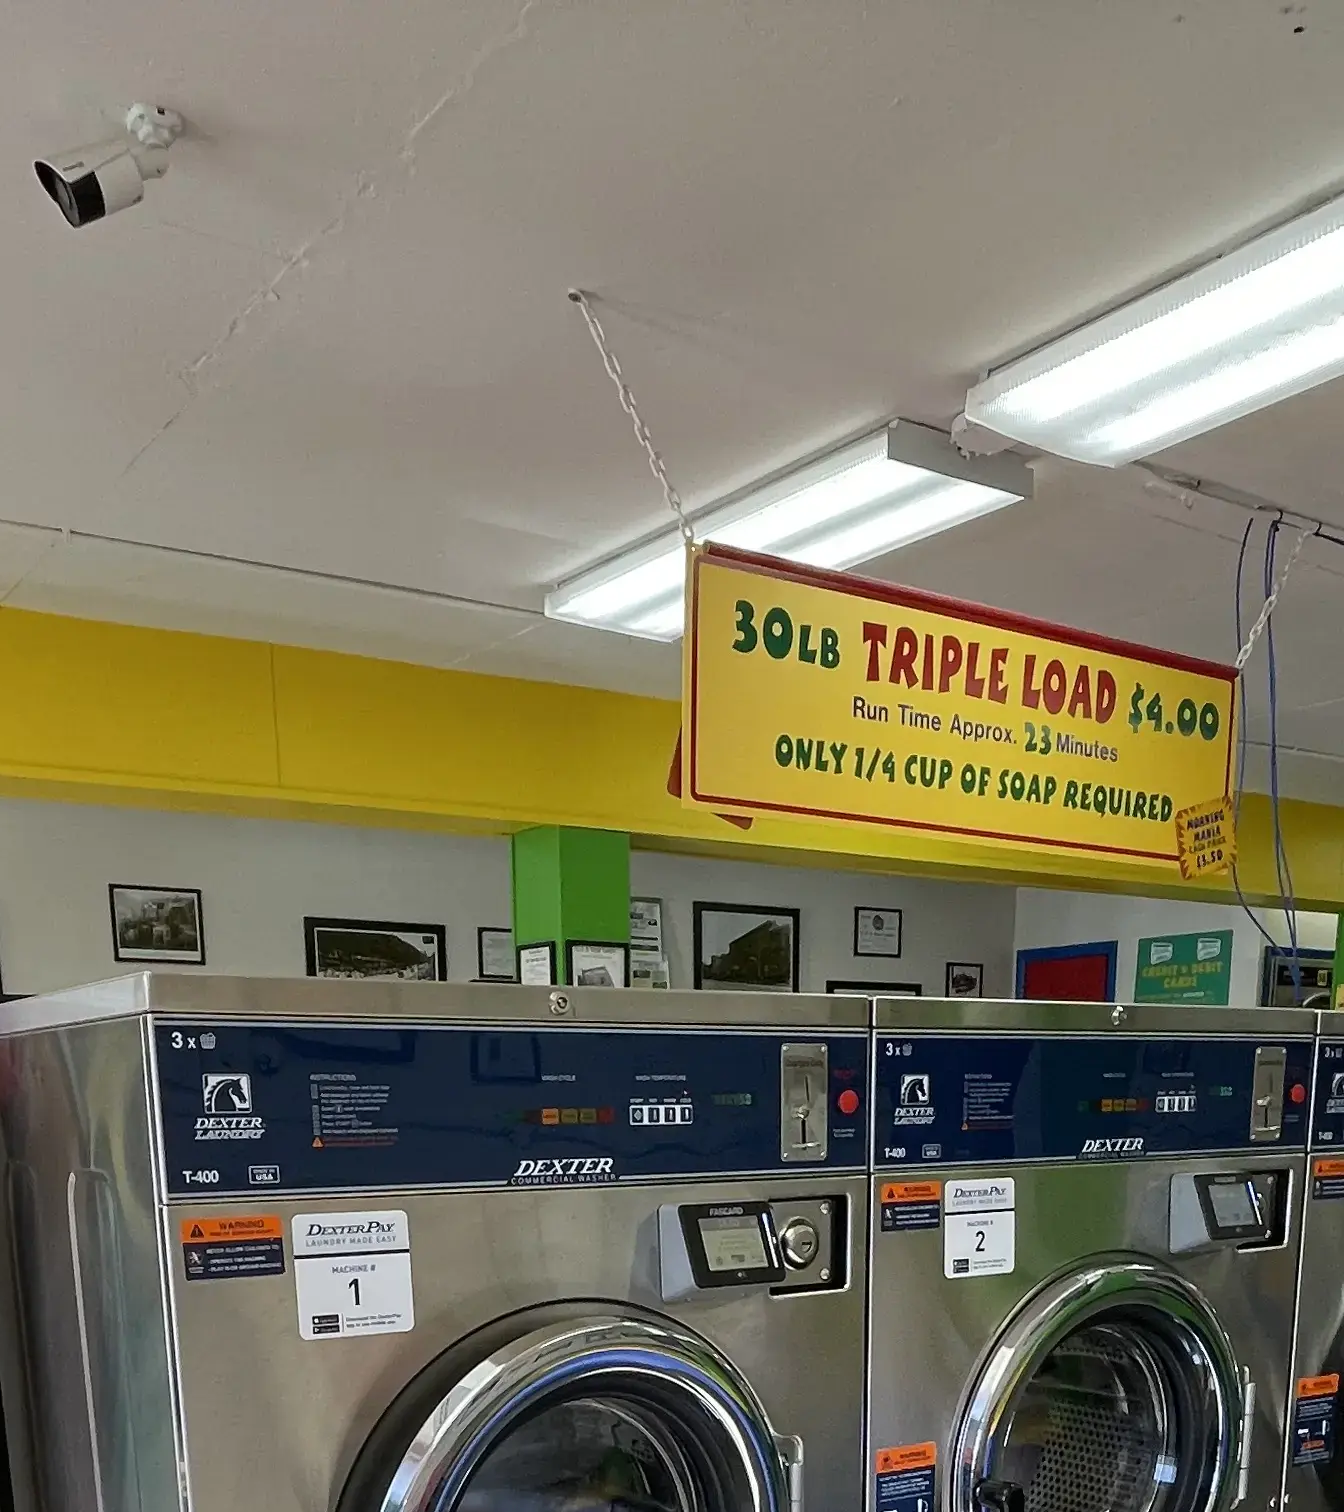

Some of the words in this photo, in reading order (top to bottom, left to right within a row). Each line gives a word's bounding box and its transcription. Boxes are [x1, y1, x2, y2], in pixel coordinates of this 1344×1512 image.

[733, 600, 840, 669] 30LB
[862, 621, 1009, 704] TRIPLE
[1022, 655, 1116, 724] LOAD
[1129, 683, 1219, 741] $4.00
[853, 696, 888, 722] Run
[898, 704, 941, 731] Time
[950, 714, 1017, 744] Approx.
[1024, 722, 1052, 755] 23
[1056, 733, 1118, 763] Minutes
[776, 735, 848, 774] ONLY
[855, 747, 895, 782] 1/4
[905, 754, 953, 790] CUP
[960, 763, 991, 796] OF
[997, 769, 1057, 805] SOAP
[1063, 780, 1172, 822] REQUIRED
[1187, 808, 1224, 830] MORNING
[1194, 825, 1221, 841] MANIA
[171, 1031, 184, 1049] 3
[187, 1037, 197, 1049] x
[885, 1042, 893, 1056] 3
[894, 1107, 935, 1117] DEXTER
[194, 1117, 264, 1130] DEXTER
[194, 1129, 265, 1140] LAUNDRY
[1082, 1137, 1144, 1153] DEXTER
[884, 1147, 907, 1159] T-400
[514, 1157, 614, 1177] DEXTER
[182, 1170, 220, 1184] T-400
[510, 1176, 575, 1186] COMMERCIAL
[578, 1173, 618, 1183] WASHER
[219, 1219, 265, 1230] WARNING
[306, 1239, 346, 1248] LAUNDRY
[349, 1237, 372, 1246] MADE
[376, 1235, 397, 1244] EASY
[975, 1230, 985, 1252] 2
[331, 1264, 369, 1275] MACHINE
[348, 1278, 361, 1306] 1
